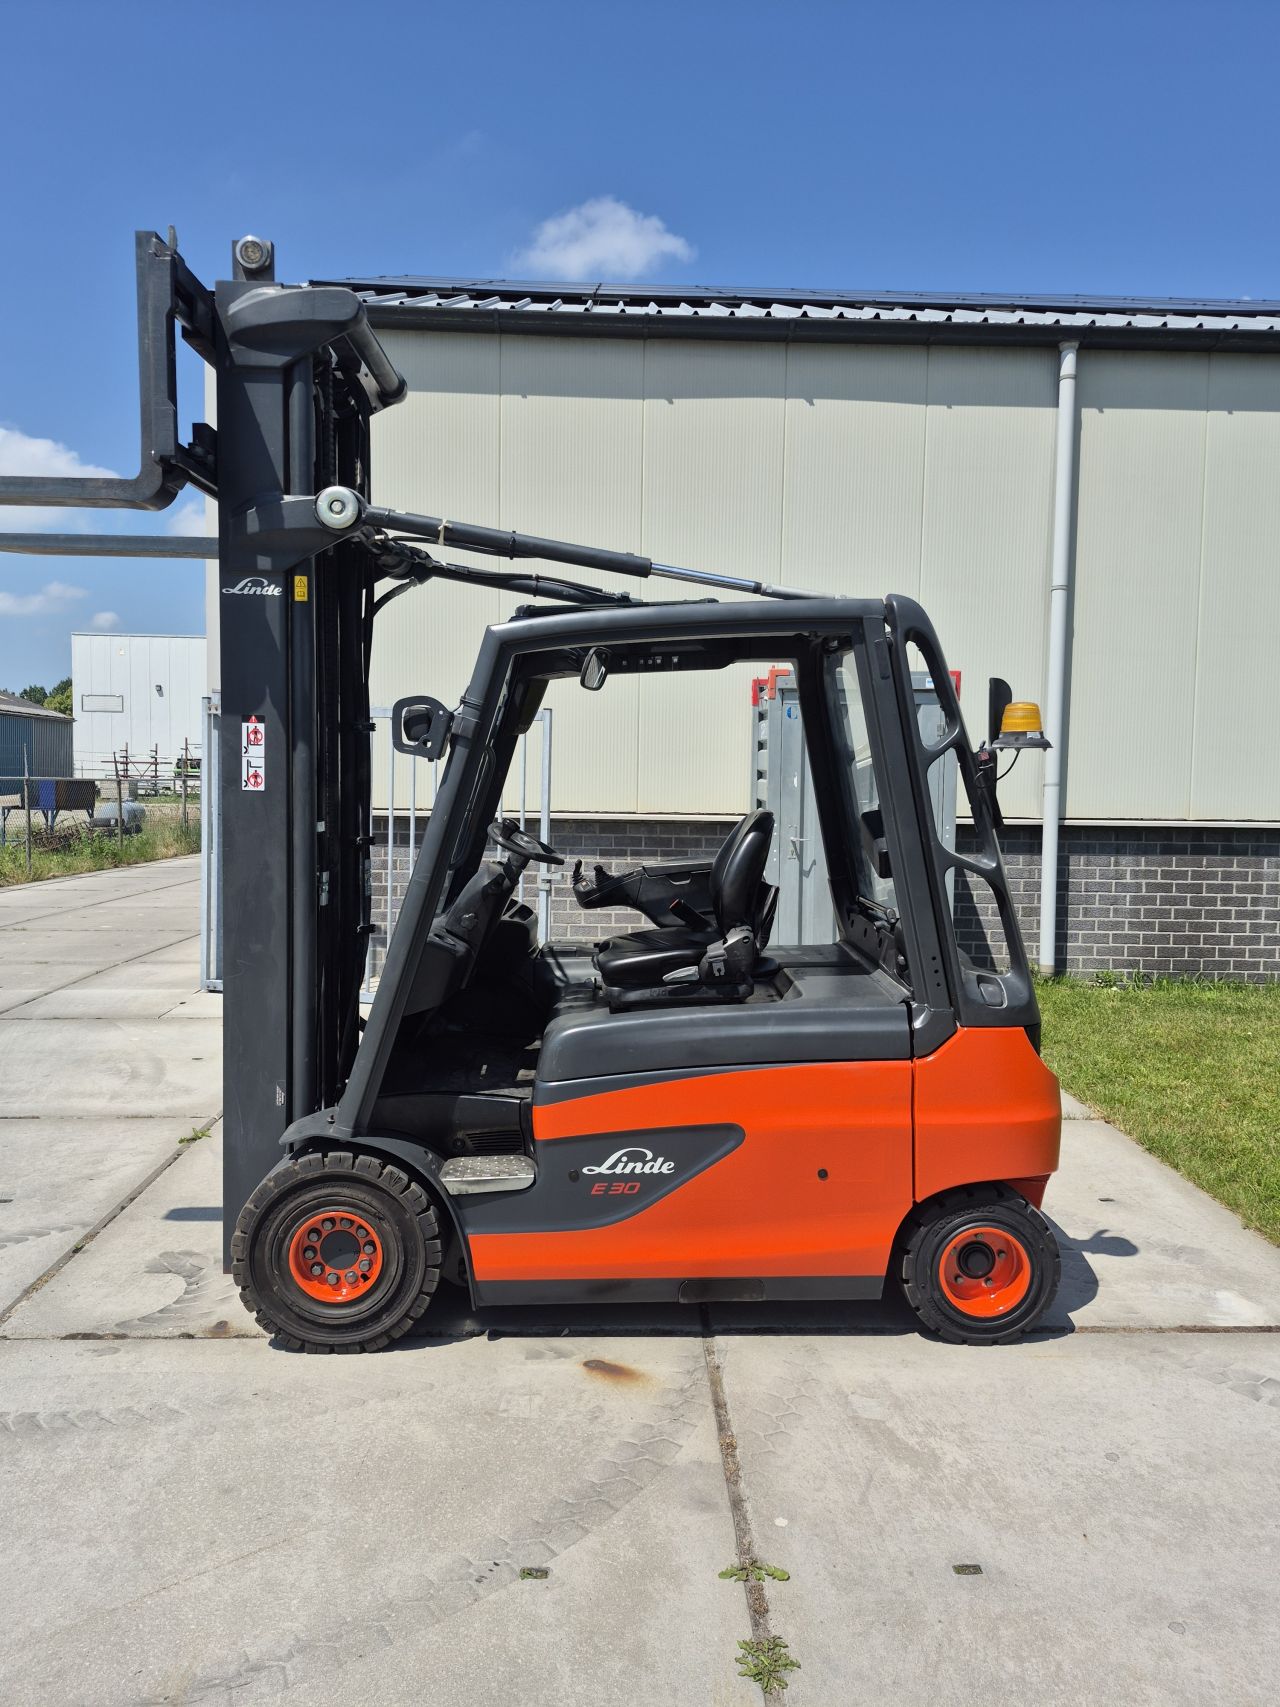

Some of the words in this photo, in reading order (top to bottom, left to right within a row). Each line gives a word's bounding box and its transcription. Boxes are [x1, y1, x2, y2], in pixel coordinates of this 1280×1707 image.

[222, 577, 282, 595] Linde
[582, 1147, 675, 1175] Linde
[591, 1182, 608, 1195] E
[608, 1182, 641, 1194] 30
